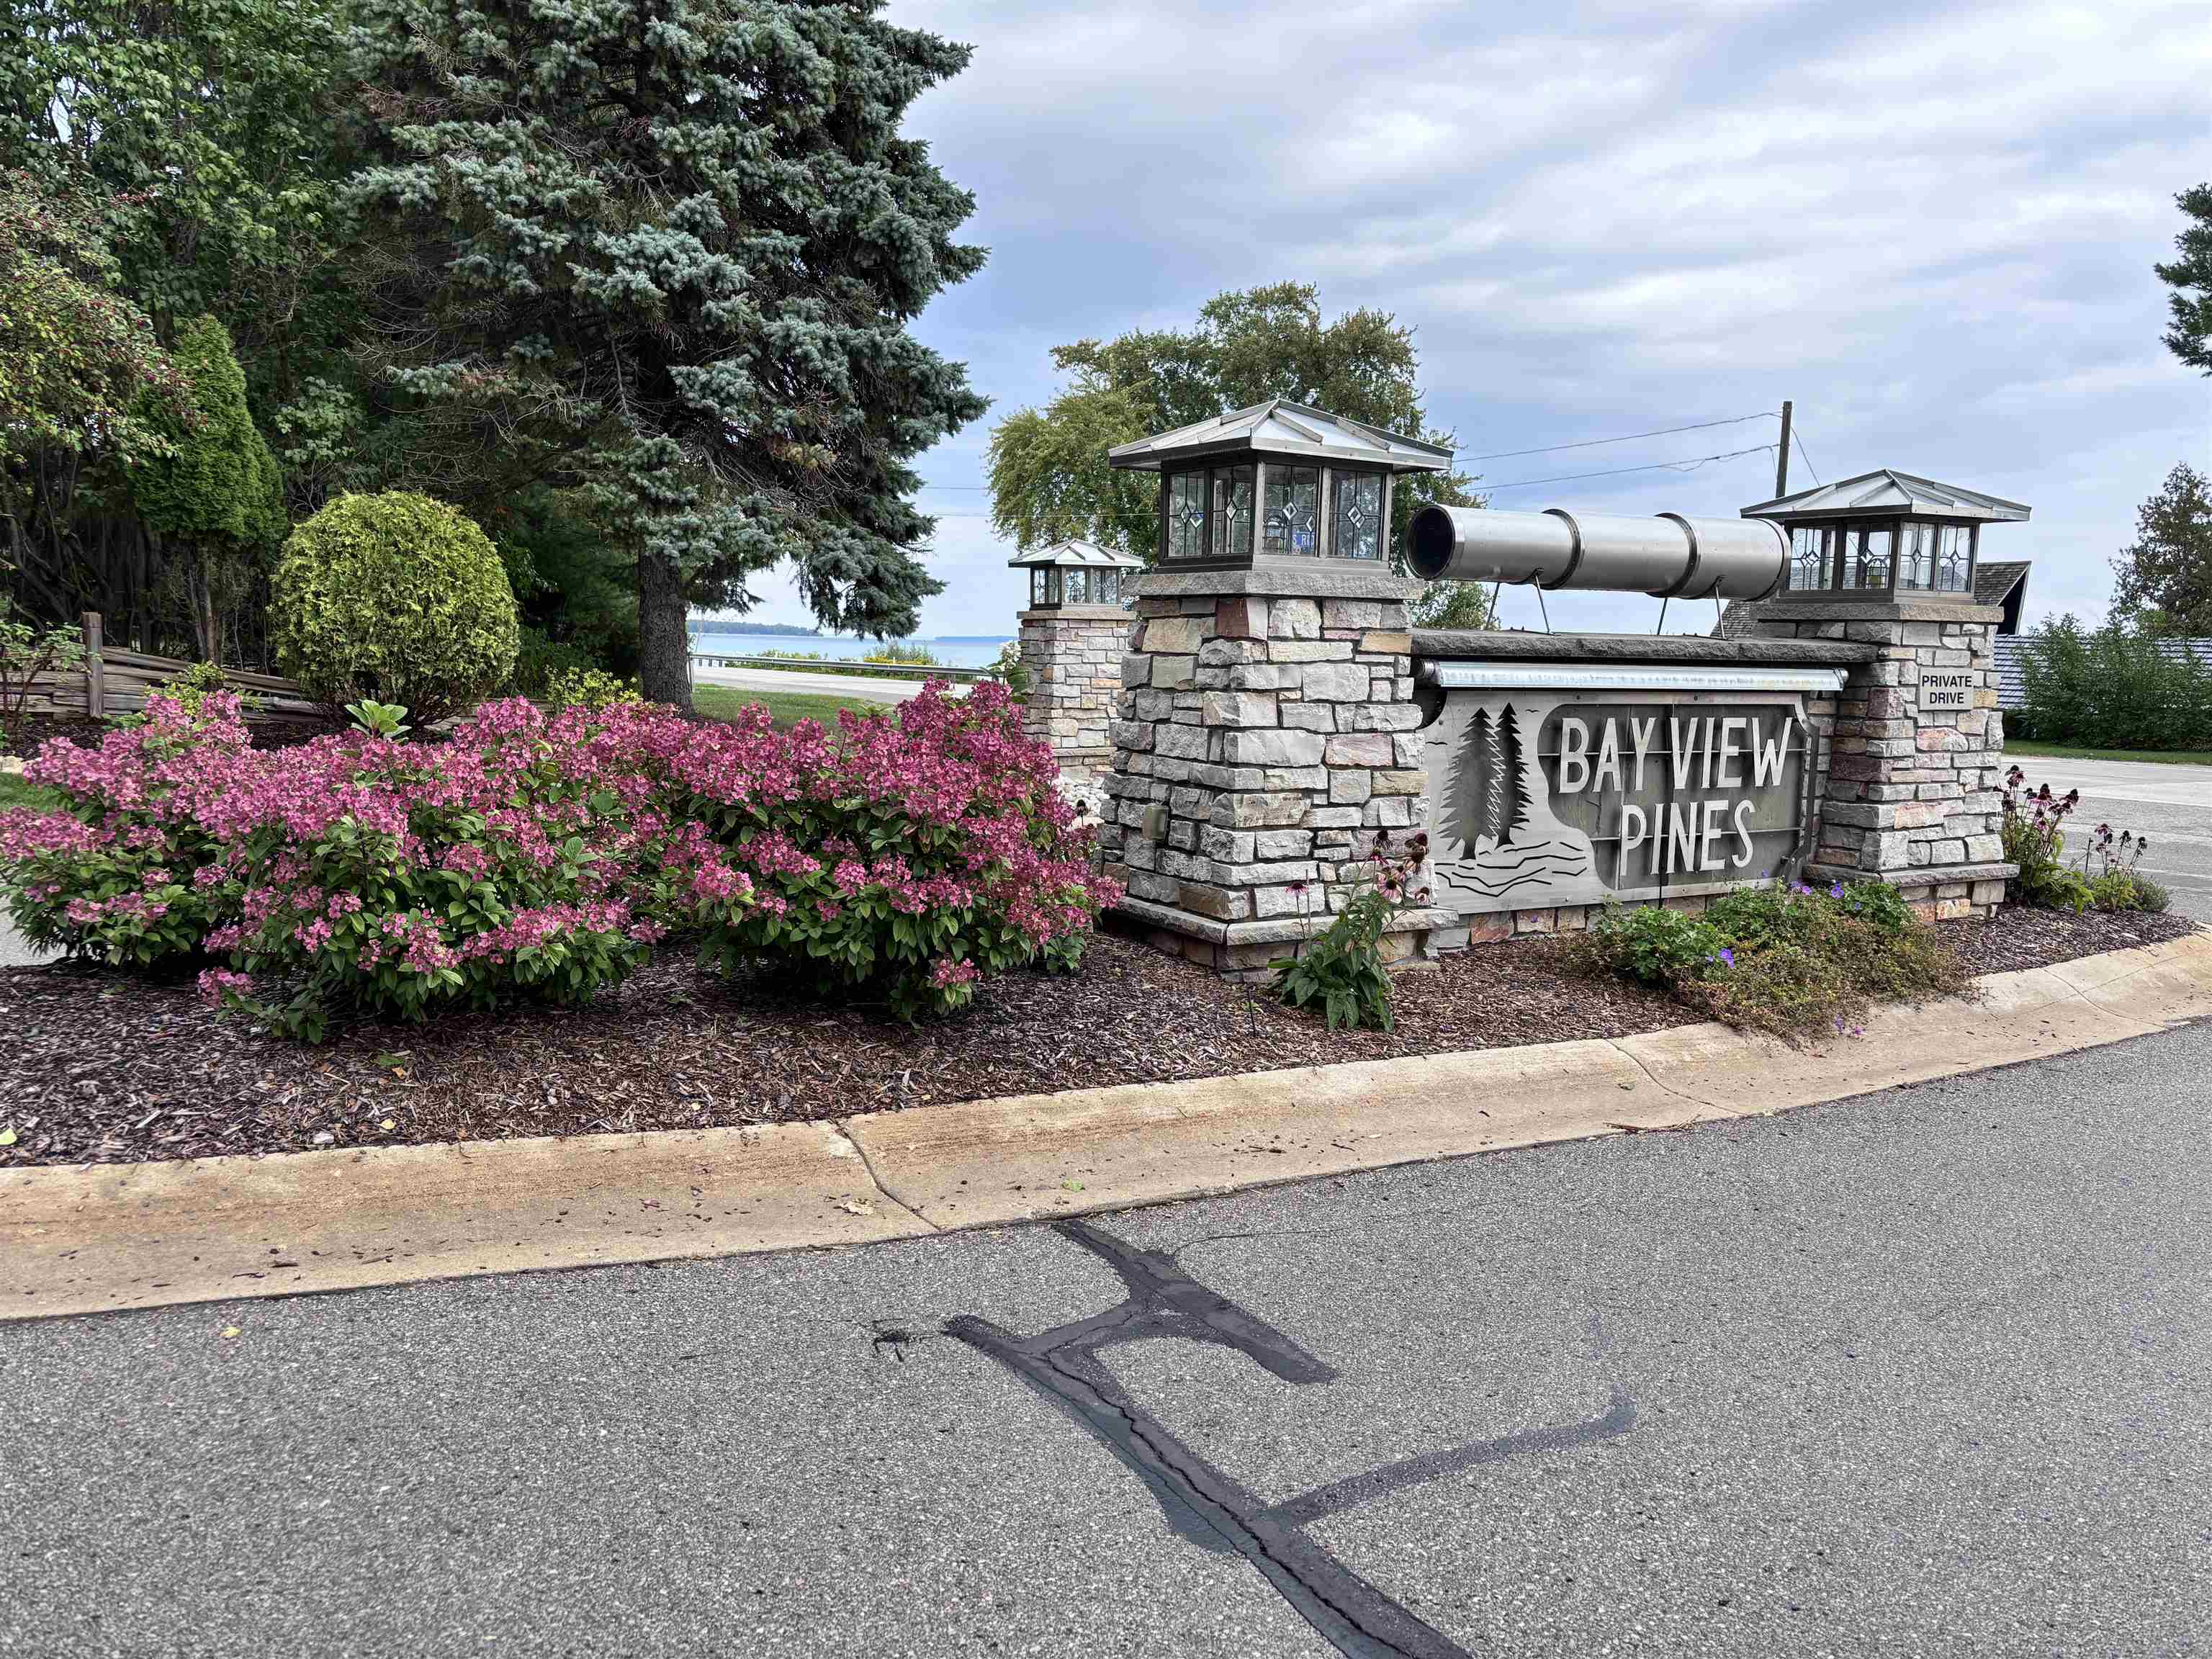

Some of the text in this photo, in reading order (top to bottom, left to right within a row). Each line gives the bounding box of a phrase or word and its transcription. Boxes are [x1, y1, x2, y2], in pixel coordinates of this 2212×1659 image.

[1922, 675, 1972, 687] PRIVATE
[1930, 692, 1964, 703] DRIVE
[1559, 717, 1793, 793] BAY VIEW
[1619, 799, 1755, 876] PINES
